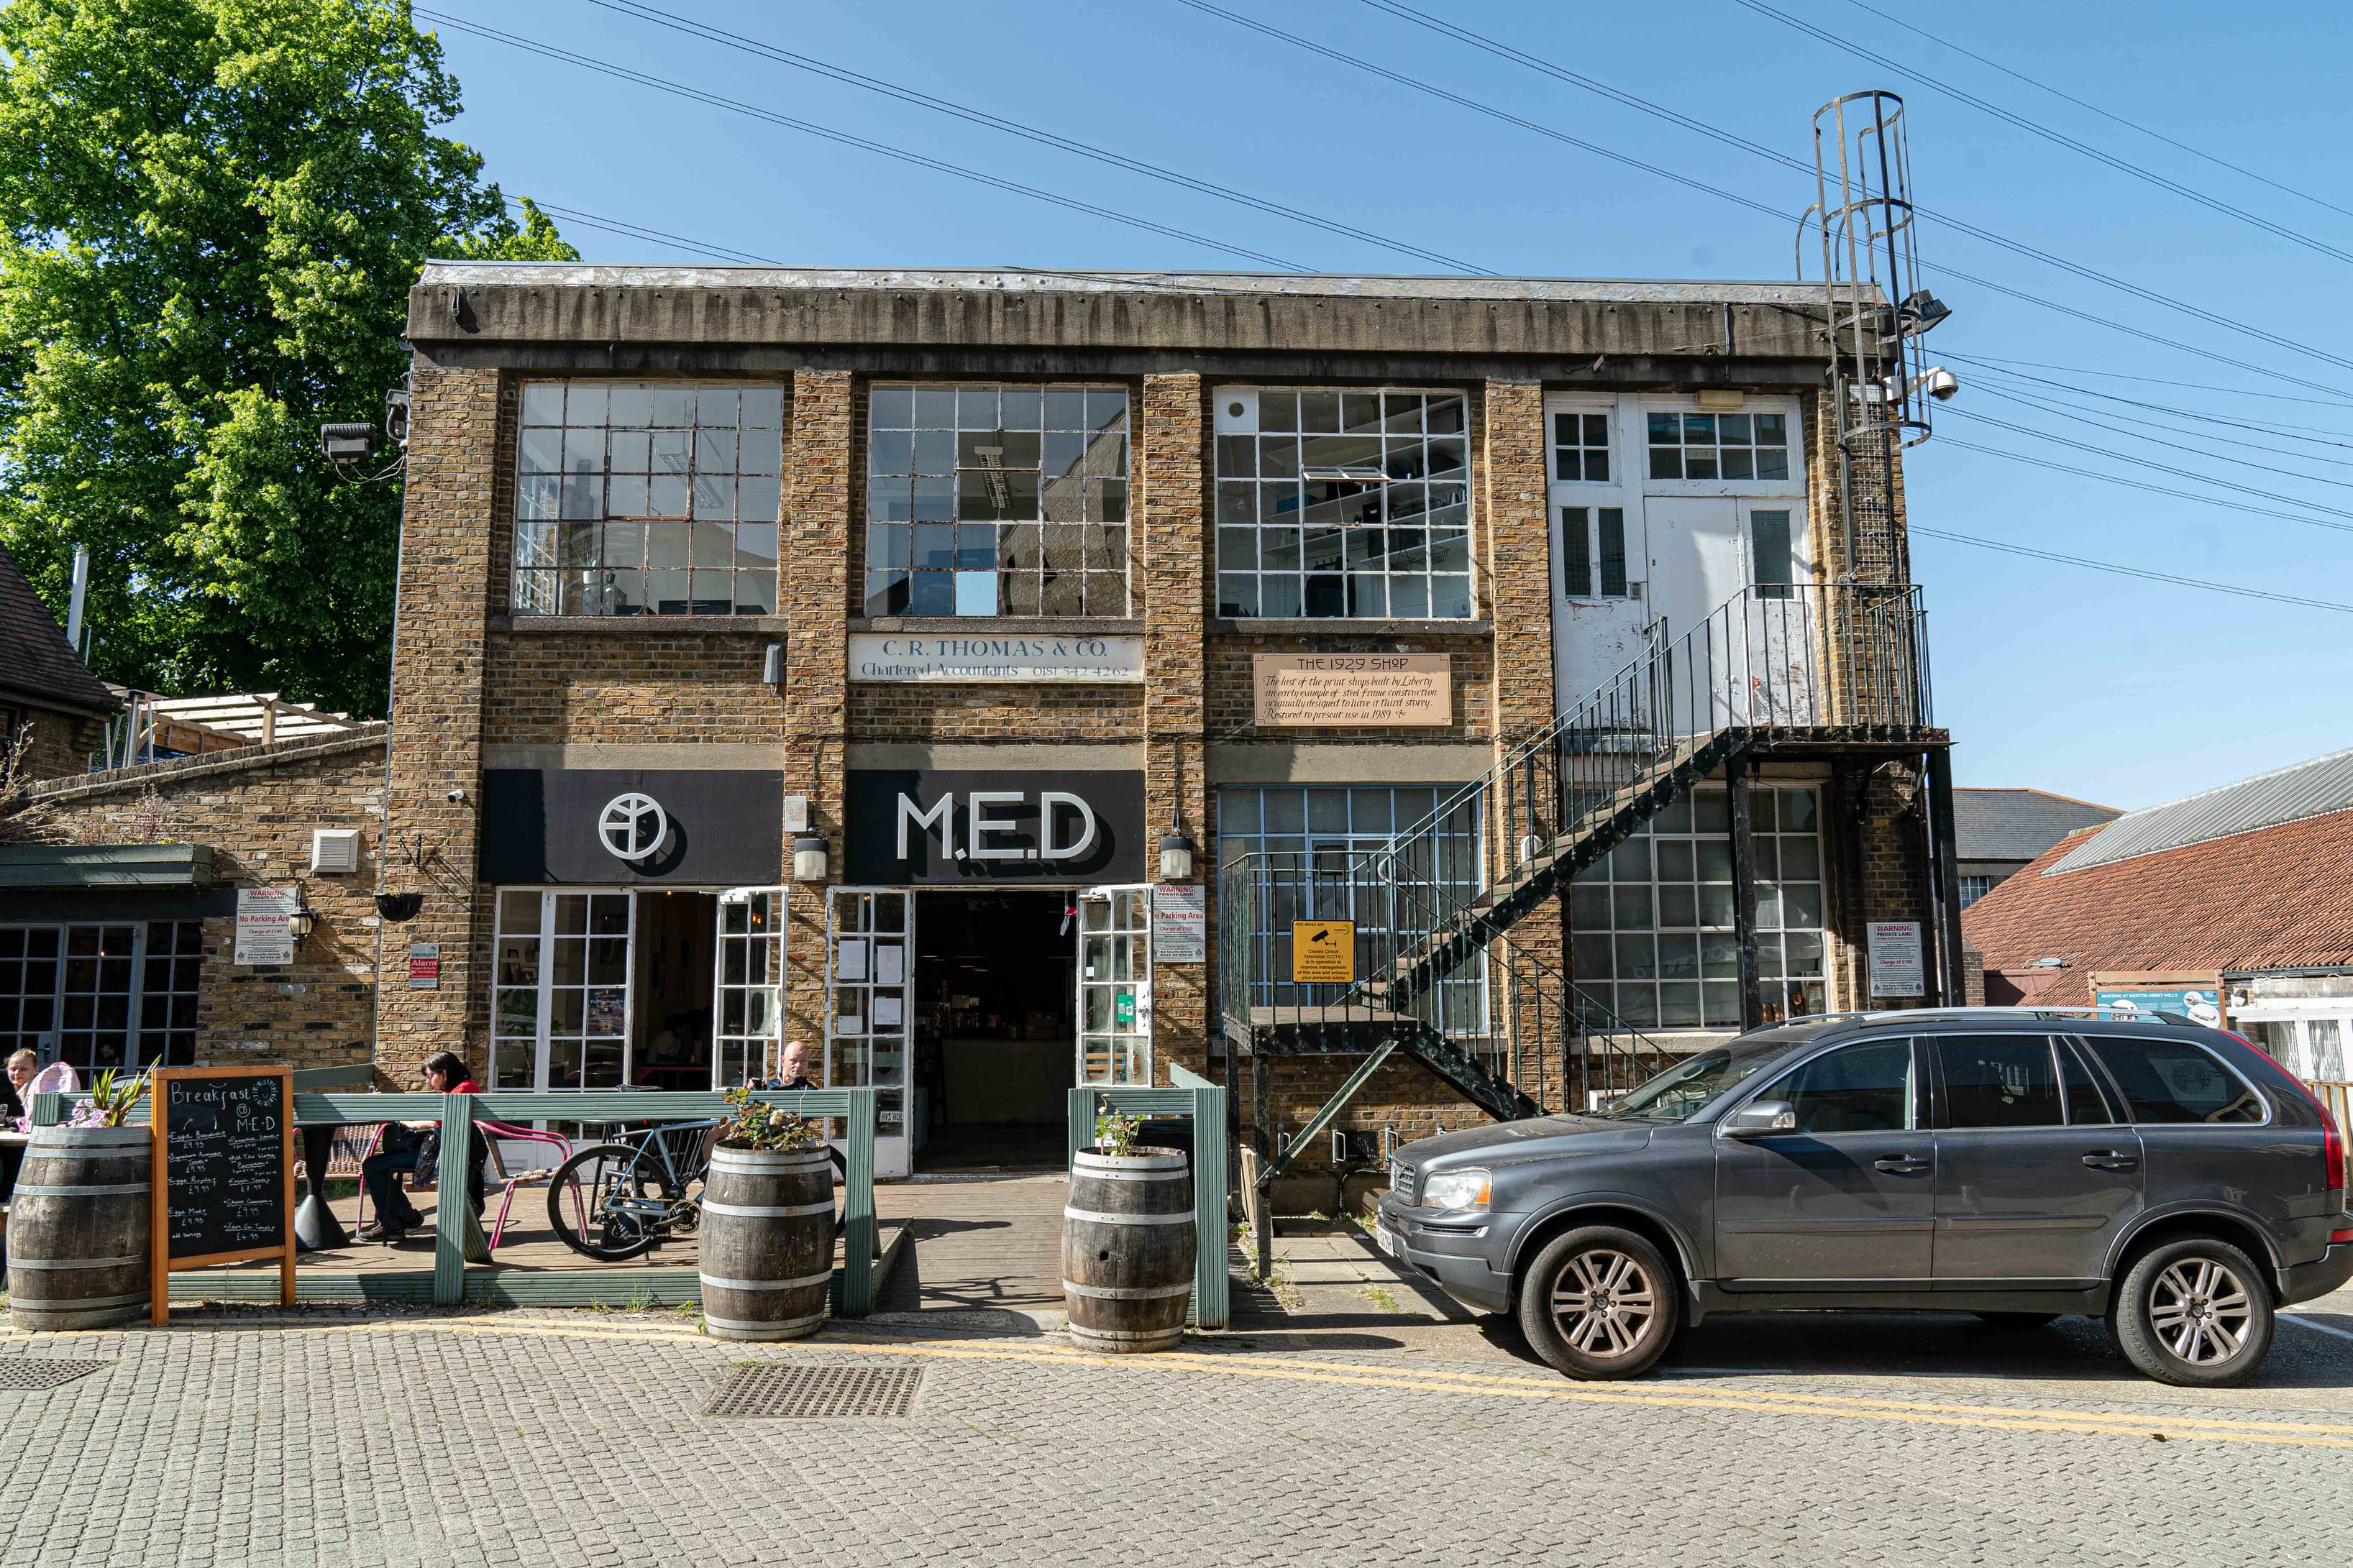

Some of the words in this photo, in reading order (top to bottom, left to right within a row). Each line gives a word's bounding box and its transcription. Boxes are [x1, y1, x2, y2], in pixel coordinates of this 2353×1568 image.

[938, 640, 1044, 656] THOMAS
[1052, 641, 1067, 656] &
[1076, 641, 1107, 656] CO.
[862, 662, 931, 677] Chartered
[935, 664, 1018, 677] Accountants
[1033, 666, 1057, 677] 0181
[1064, 666, 1087, 677] 542
[1092, 666, 1128, 677] 4262
[1297, 659, 1325, 670] THE
[1330, 659, 1365, 670] 1929
[1263, 676, 1279, 686] The
[1281, 677, 1296, 686] last
[1298, 677, 1307, 687] of
[1309, 677, 1322, 686] the
[1325, 677, 1346, 689] print
[1348, 677, 1371, 689] shops
[1371, 677, 1389, 686] built
[1392, 677, 1401, 687] by
[1401, 676, 1433, 687] Liberty
[1277, 689, 1299, 700] early
[1300, 689, 1329, 699] example
[1330, 689, 1340, 700] of
[1361, 689, 1386, 700] frame
[1266, 699, 1306, 709] originally
[1306, 699, 1340, 709] designed
[1351, 699, 1370, 707] have
[1381, 698, 1402, 707] third
[1405, 699, 1433, 710] storey.
[1264, 708, 1301, 719] Restored
[1305, 710, 1312, 719] to
[1313, 711, 1341, 722] present
[1361, 710, 1369, 719] in
[1372, 709, 1392, 720] 1989
[171, 1082, 250, 1109] Breakfast
[236, 1103, 251, 1118] @
